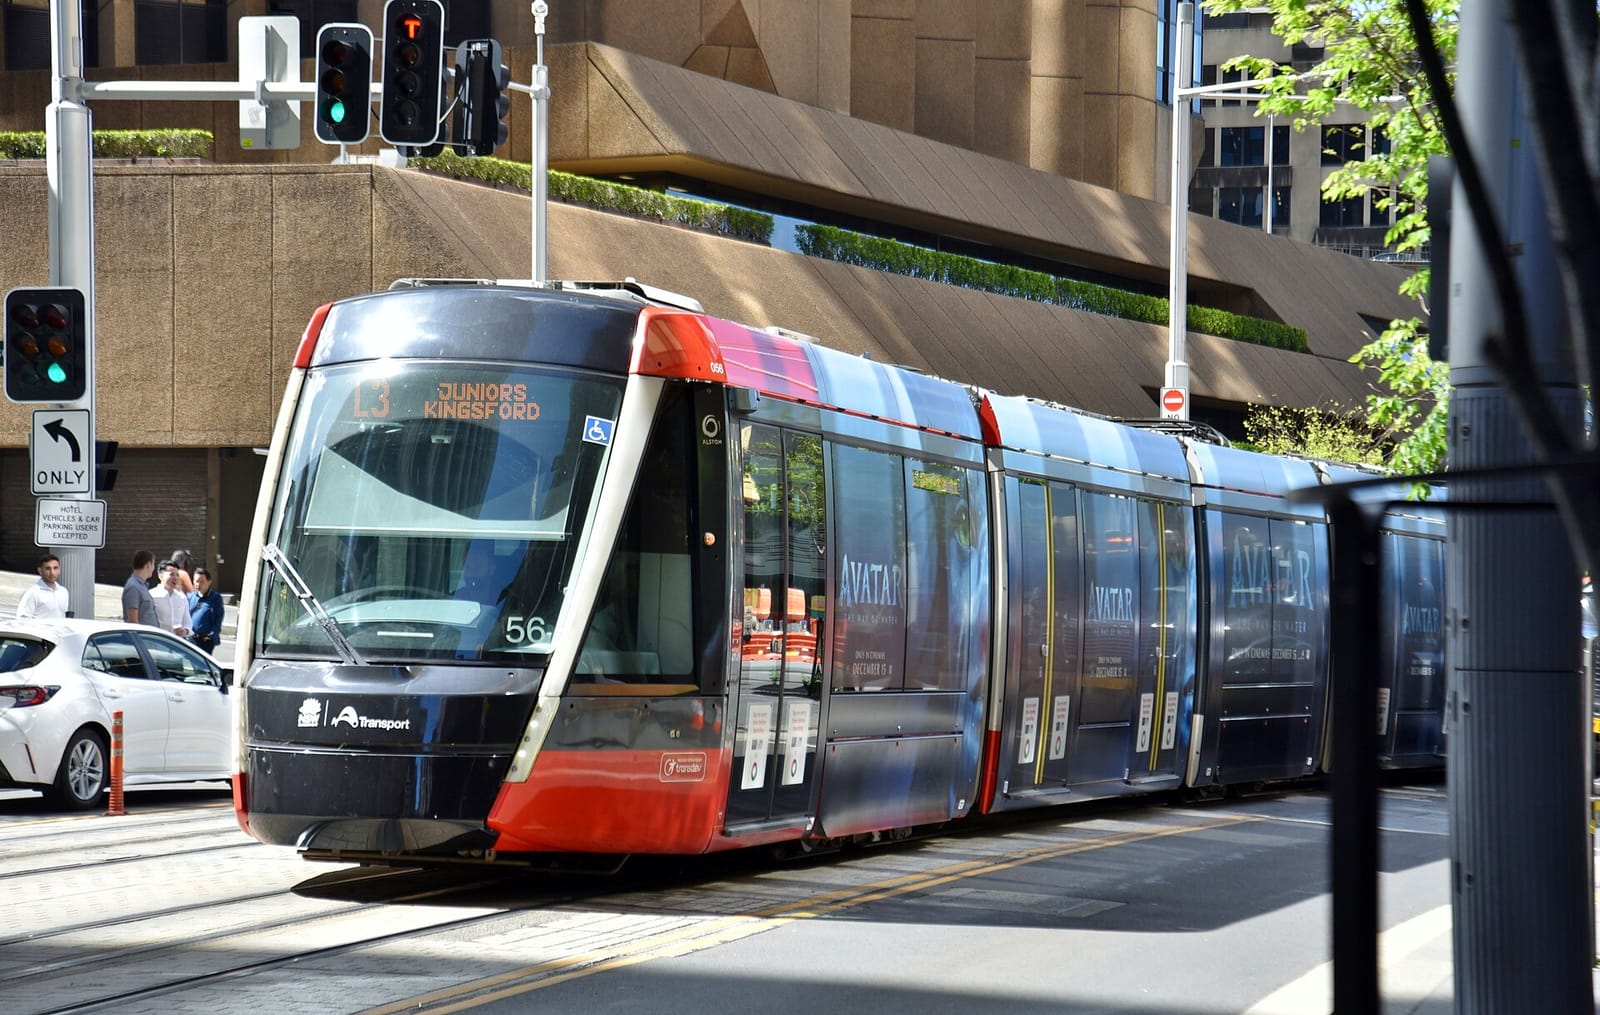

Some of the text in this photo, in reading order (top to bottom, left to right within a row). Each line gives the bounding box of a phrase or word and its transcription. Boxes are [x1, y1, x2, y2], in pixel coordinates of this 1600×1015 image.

[353, 380, 391, 418] L3
[438, 382, 528, 402] JUNIORS
[423, 401, 541, 421] KINGSFORD
[37, 470, 85, 485] ONLY
[42, 514, 76, 522] VEHICLES
[61, 505, 82, 513] HOTEL
[839, 552, 904, 608] AVATAR
[1087, 580, 1134, 622] AVATAR
[505, 616, 546, 644] 56
[359, 715, 411, 732] Transport
